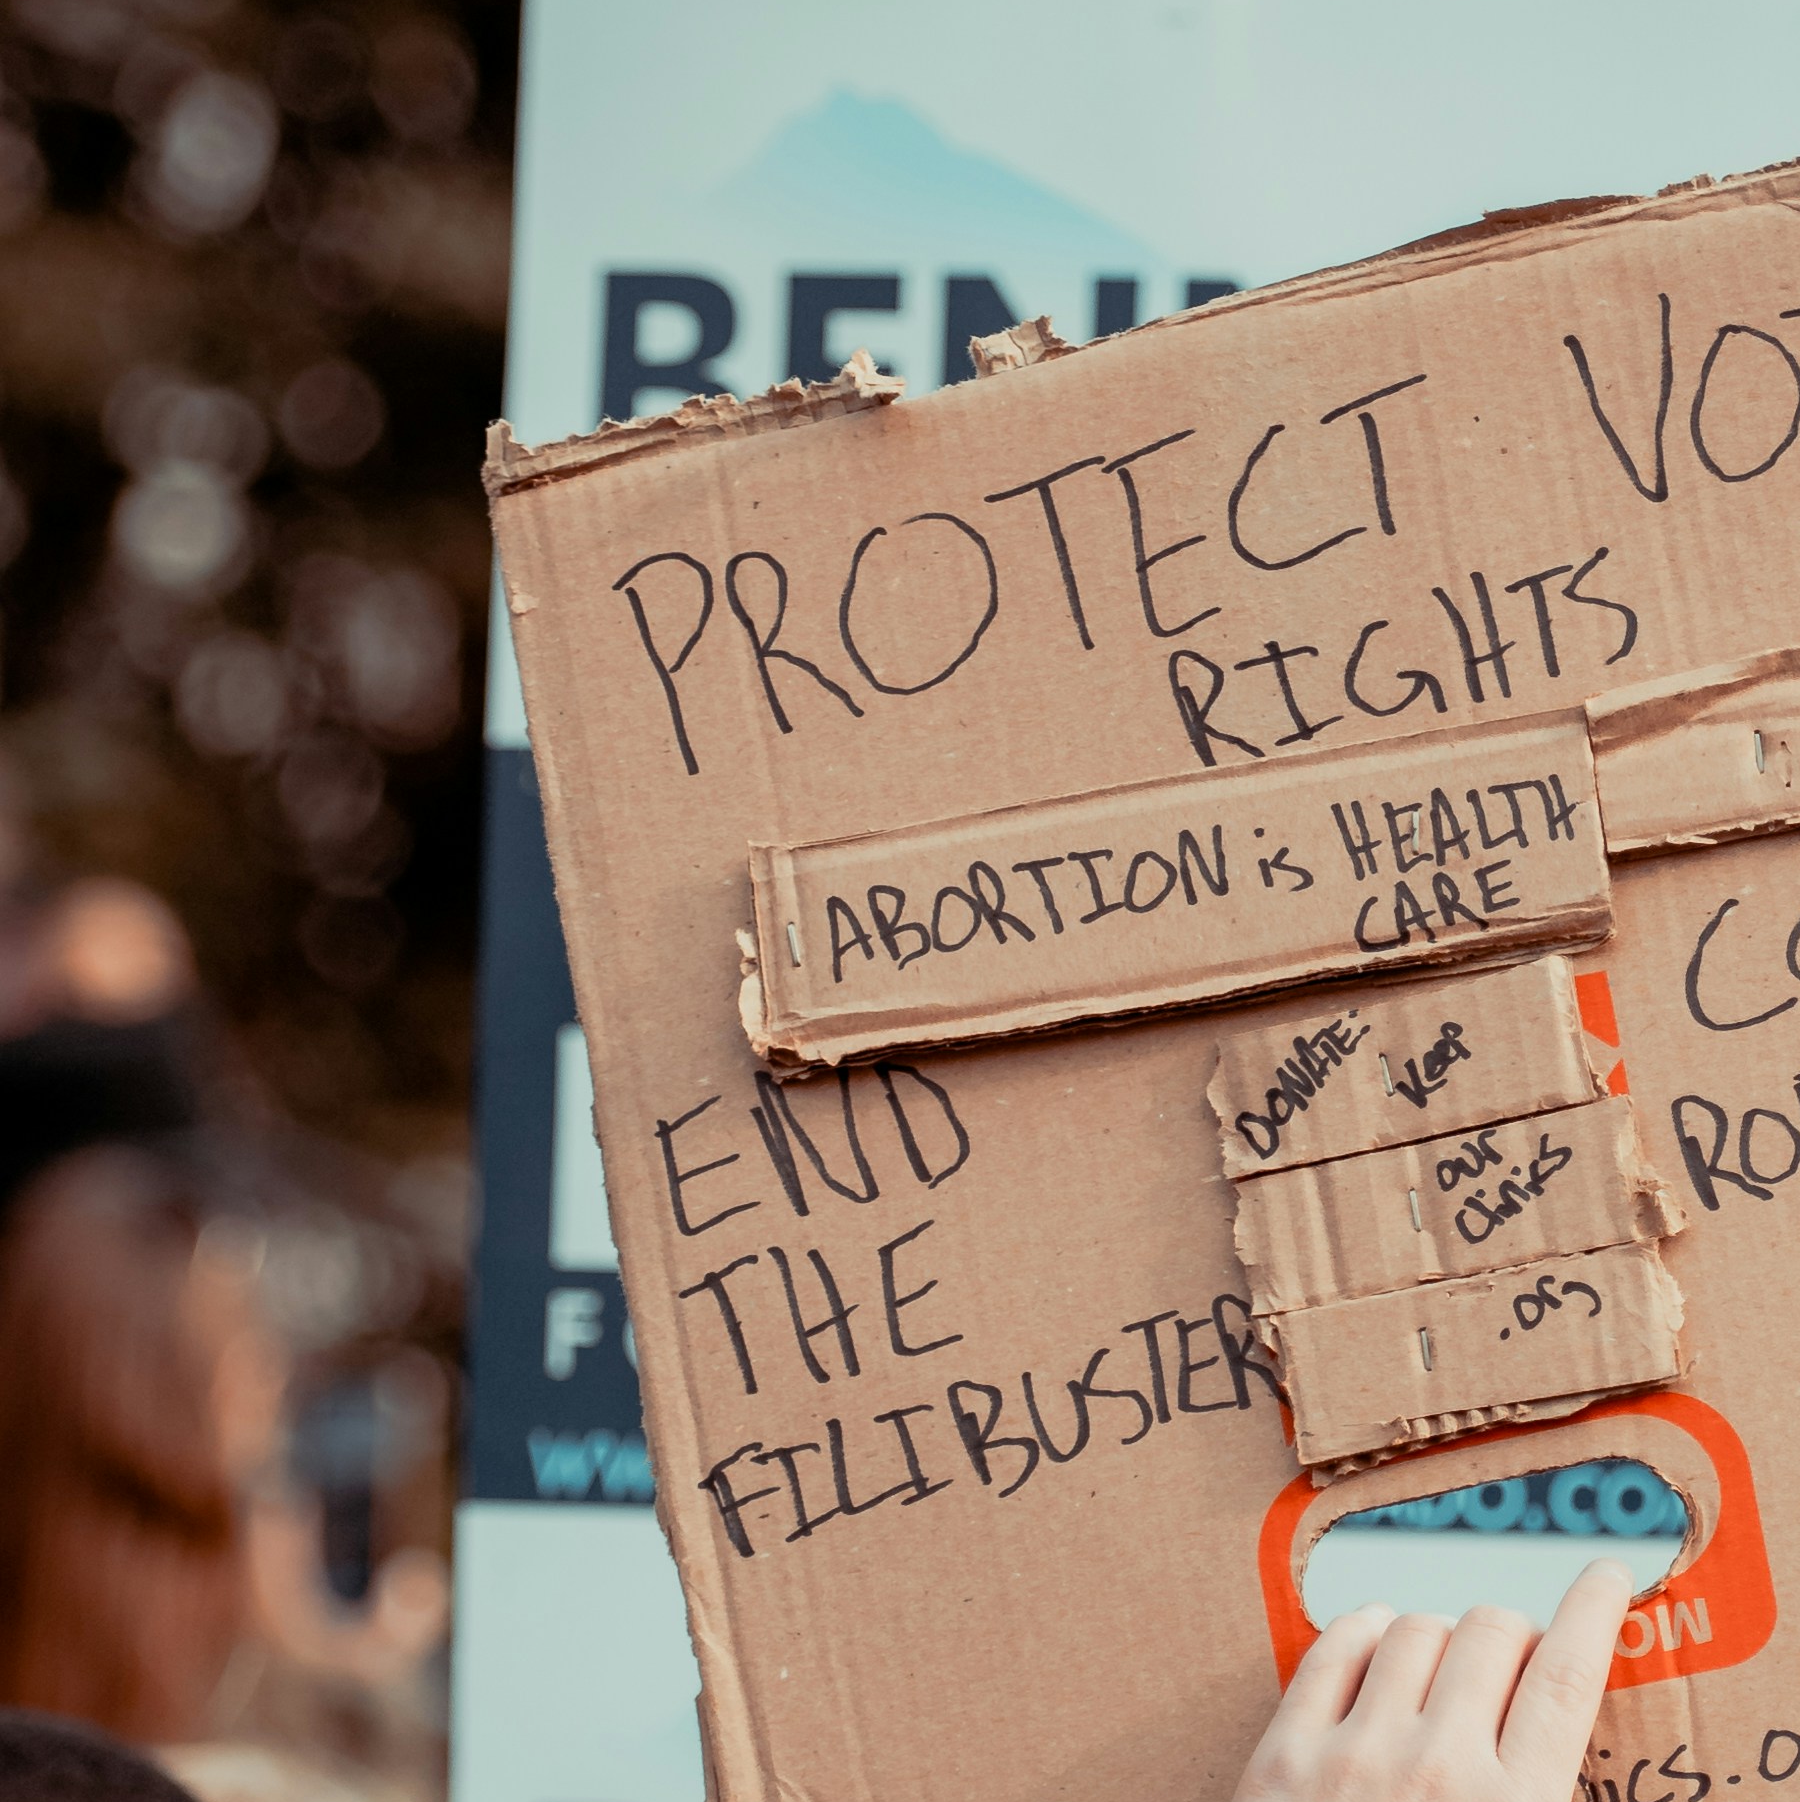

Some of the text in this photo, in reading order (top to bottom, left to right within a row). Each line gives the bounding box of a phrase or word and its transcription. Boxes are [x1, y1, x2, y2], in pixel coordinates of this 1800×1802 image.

[612, 374, 1427, 776] PROTECT
[1168, 547, 1638, 768] RIGHTS
[826, 773, 1578, 983] ABORTION is HEALTH
[1354, 859, 1521, 953] CARE
[655, 1063, 970, 1236] END
[679, 1219, 964, 1395] THE
[699, 1293, 1287, 1558] FILIBUSTER
